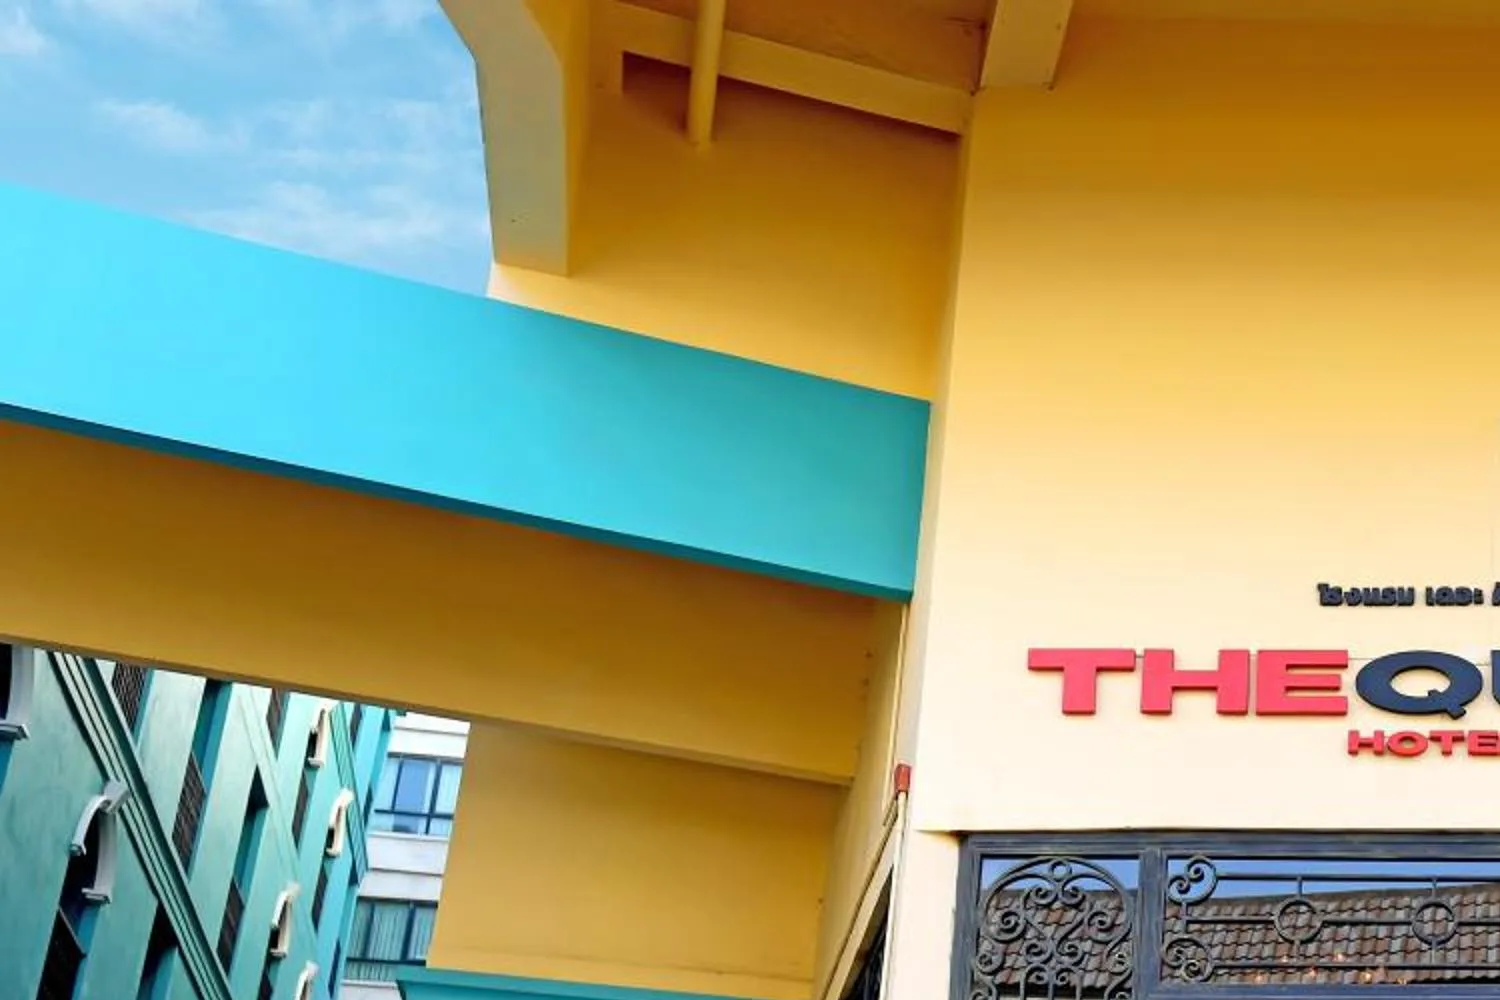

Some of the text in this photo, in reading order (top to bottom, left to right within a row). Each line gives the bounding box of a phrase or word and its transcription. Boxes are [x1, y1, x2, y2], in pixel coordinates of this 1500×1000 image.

[1317, 582, 1415, 607] โรงแรม
[1425, 585, 1485, 607] เดอะ
